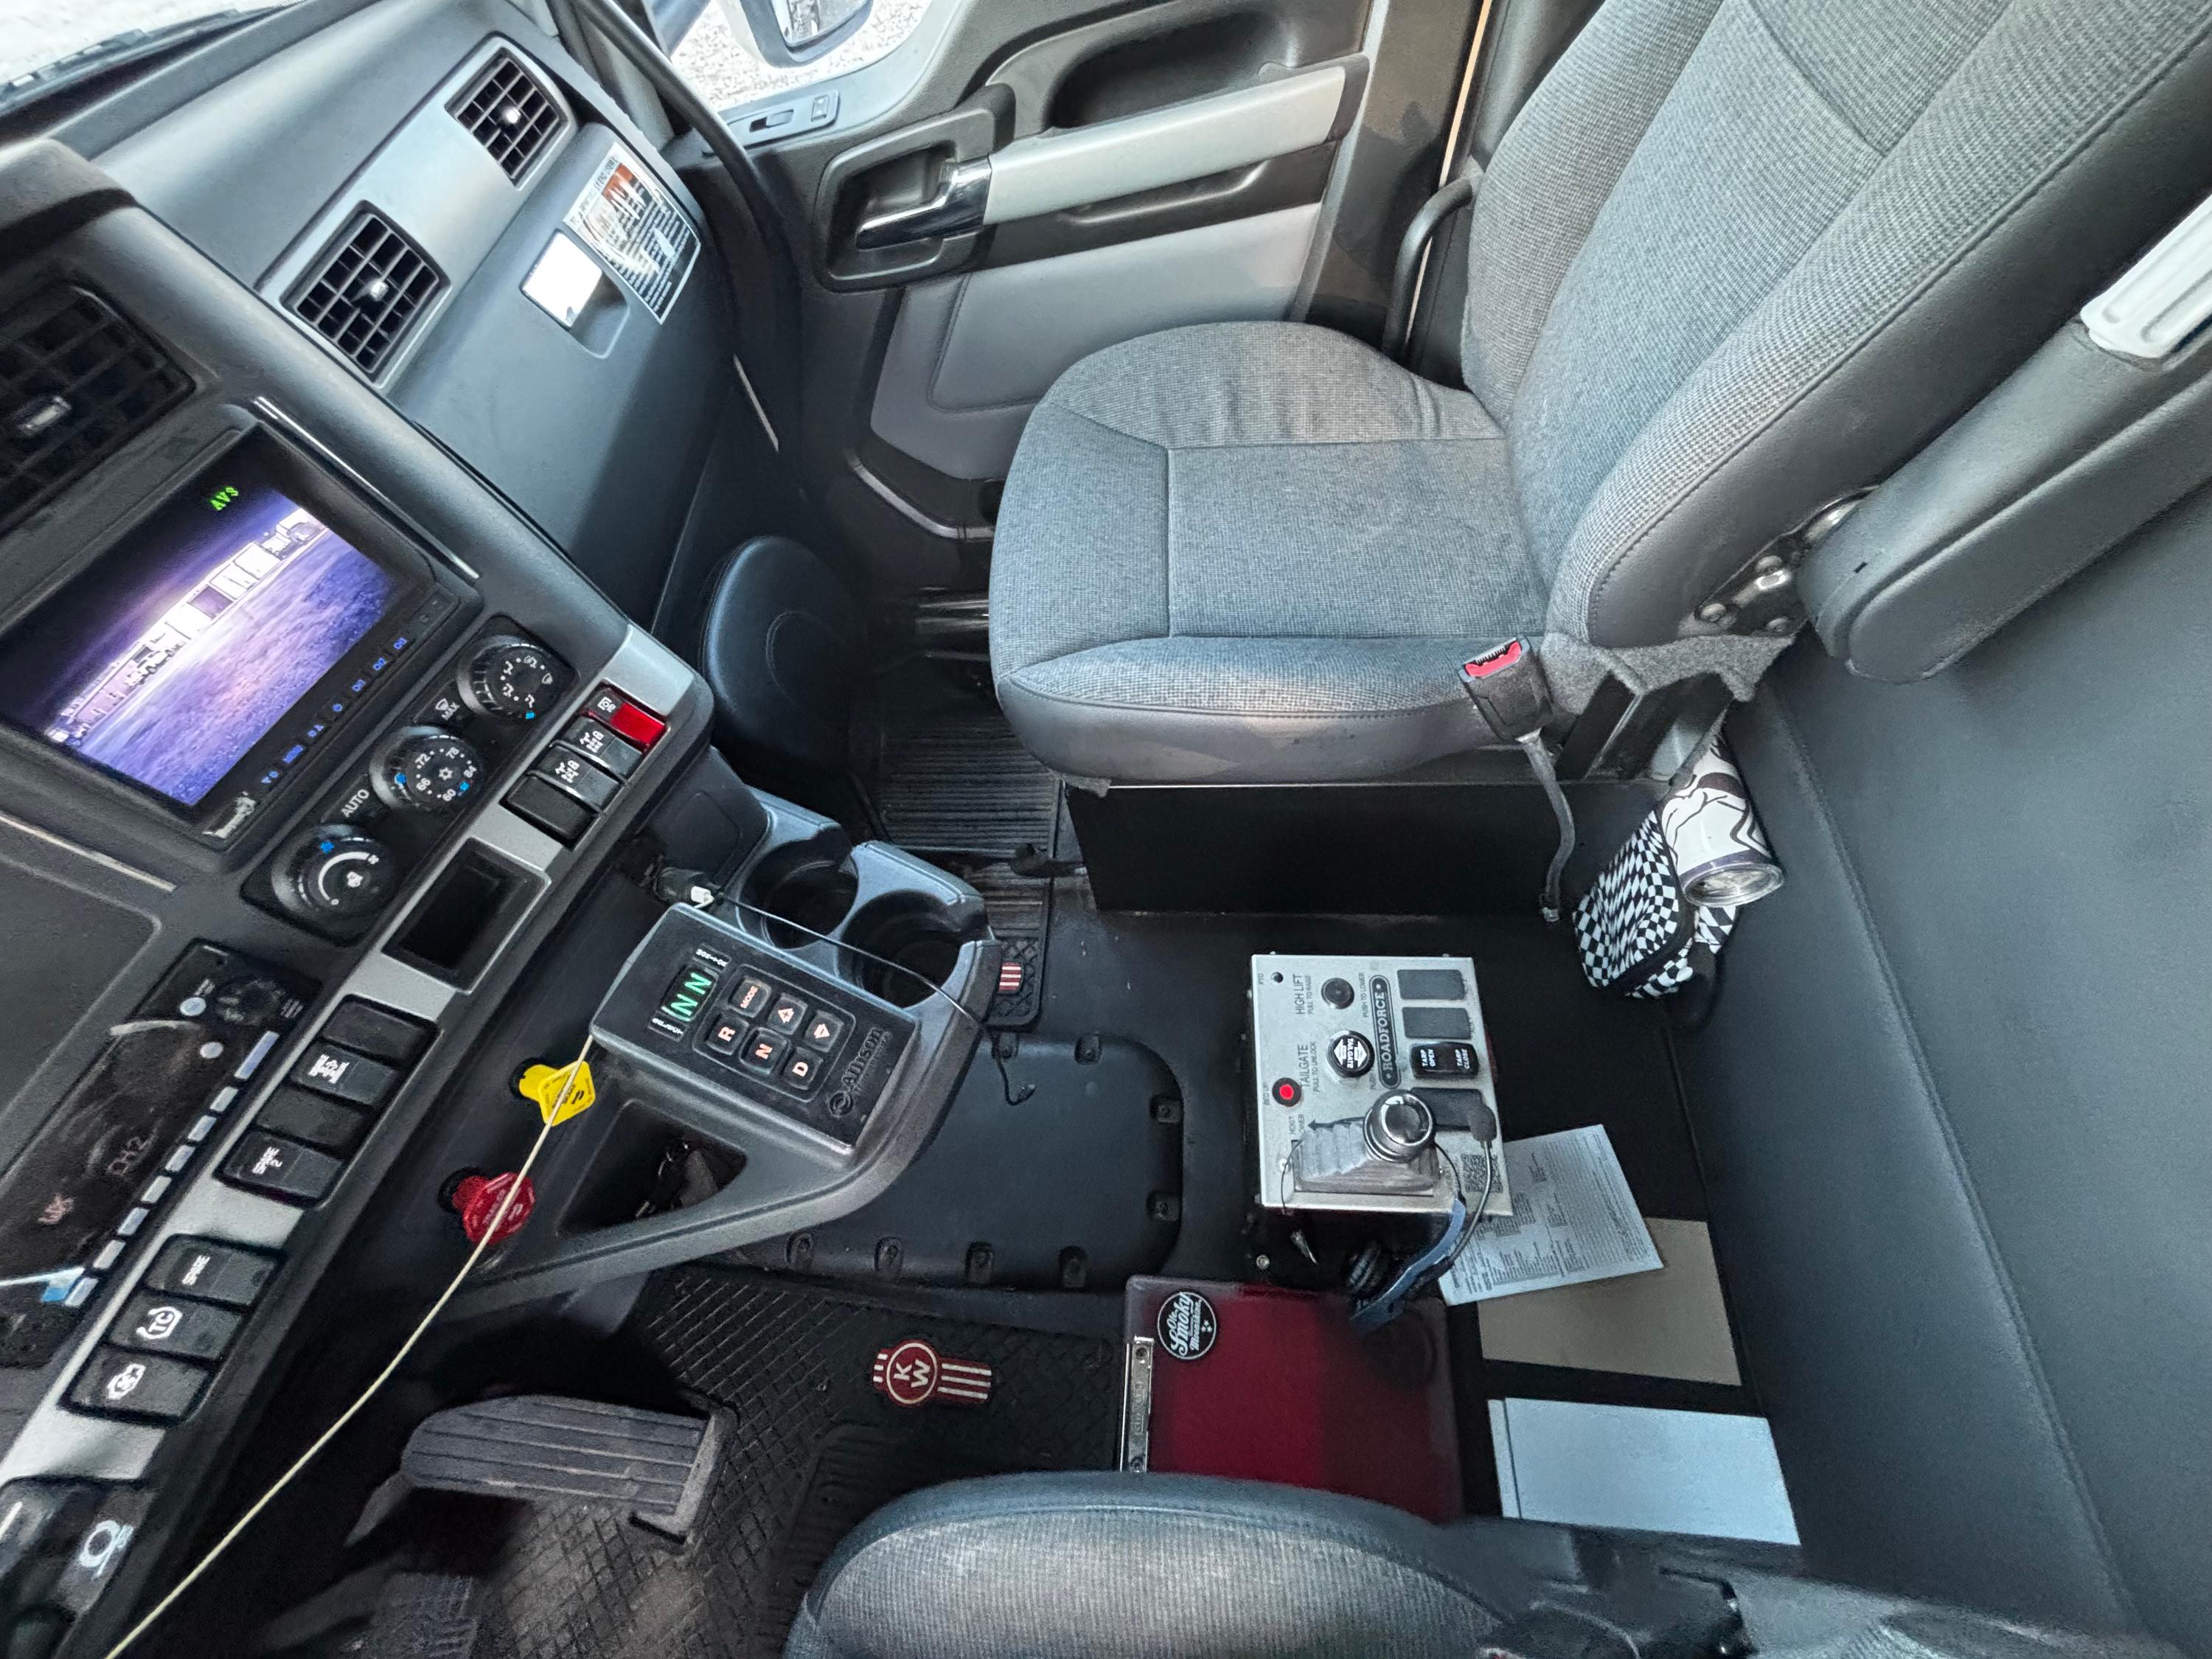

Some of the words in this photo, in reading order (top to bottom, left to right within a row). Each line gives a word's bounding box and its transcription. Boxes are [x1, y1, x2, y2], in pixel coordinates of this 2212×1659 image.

[442, 701, 461, 720] MAX
[415, 753, 431, 766] 72
[445, 747, 459, 759] 78
[463, 765, 477, 778] 84
[416, 778, 431, 791] 66
[341, 788, 370, 818] AUTO
[442, 788, 456, 801] 60
[1293, 973, 1304, 992] LIFT
[740, 985, 759, 1009] MODE
[1294, 993, 1305, 1015] HIGH
[718, 1026, 736, 1042] R
[1374, 992, 1393, 1071] ROADFORCE
[755, 1043, 773, 1060] N
[1420, 1048, 1428, 1067] TARP
[1427, 1048, 1436, 1067] OPEN
[1455, 1048, 1464, 1067] TARP
[1461, 1048, 1470, 1069] CLOSE
[792, 1061, 809, 1077] D
[1298, 1044, 1310, 1088] TAILGATE
[148, 1312, 174, 1333] TC
[1166, 1309, 1178, 1330] Ole
[1169, 1292, 1194, 1356] Smoky
[1189, 1299, 1202, 1352] Moonshine
